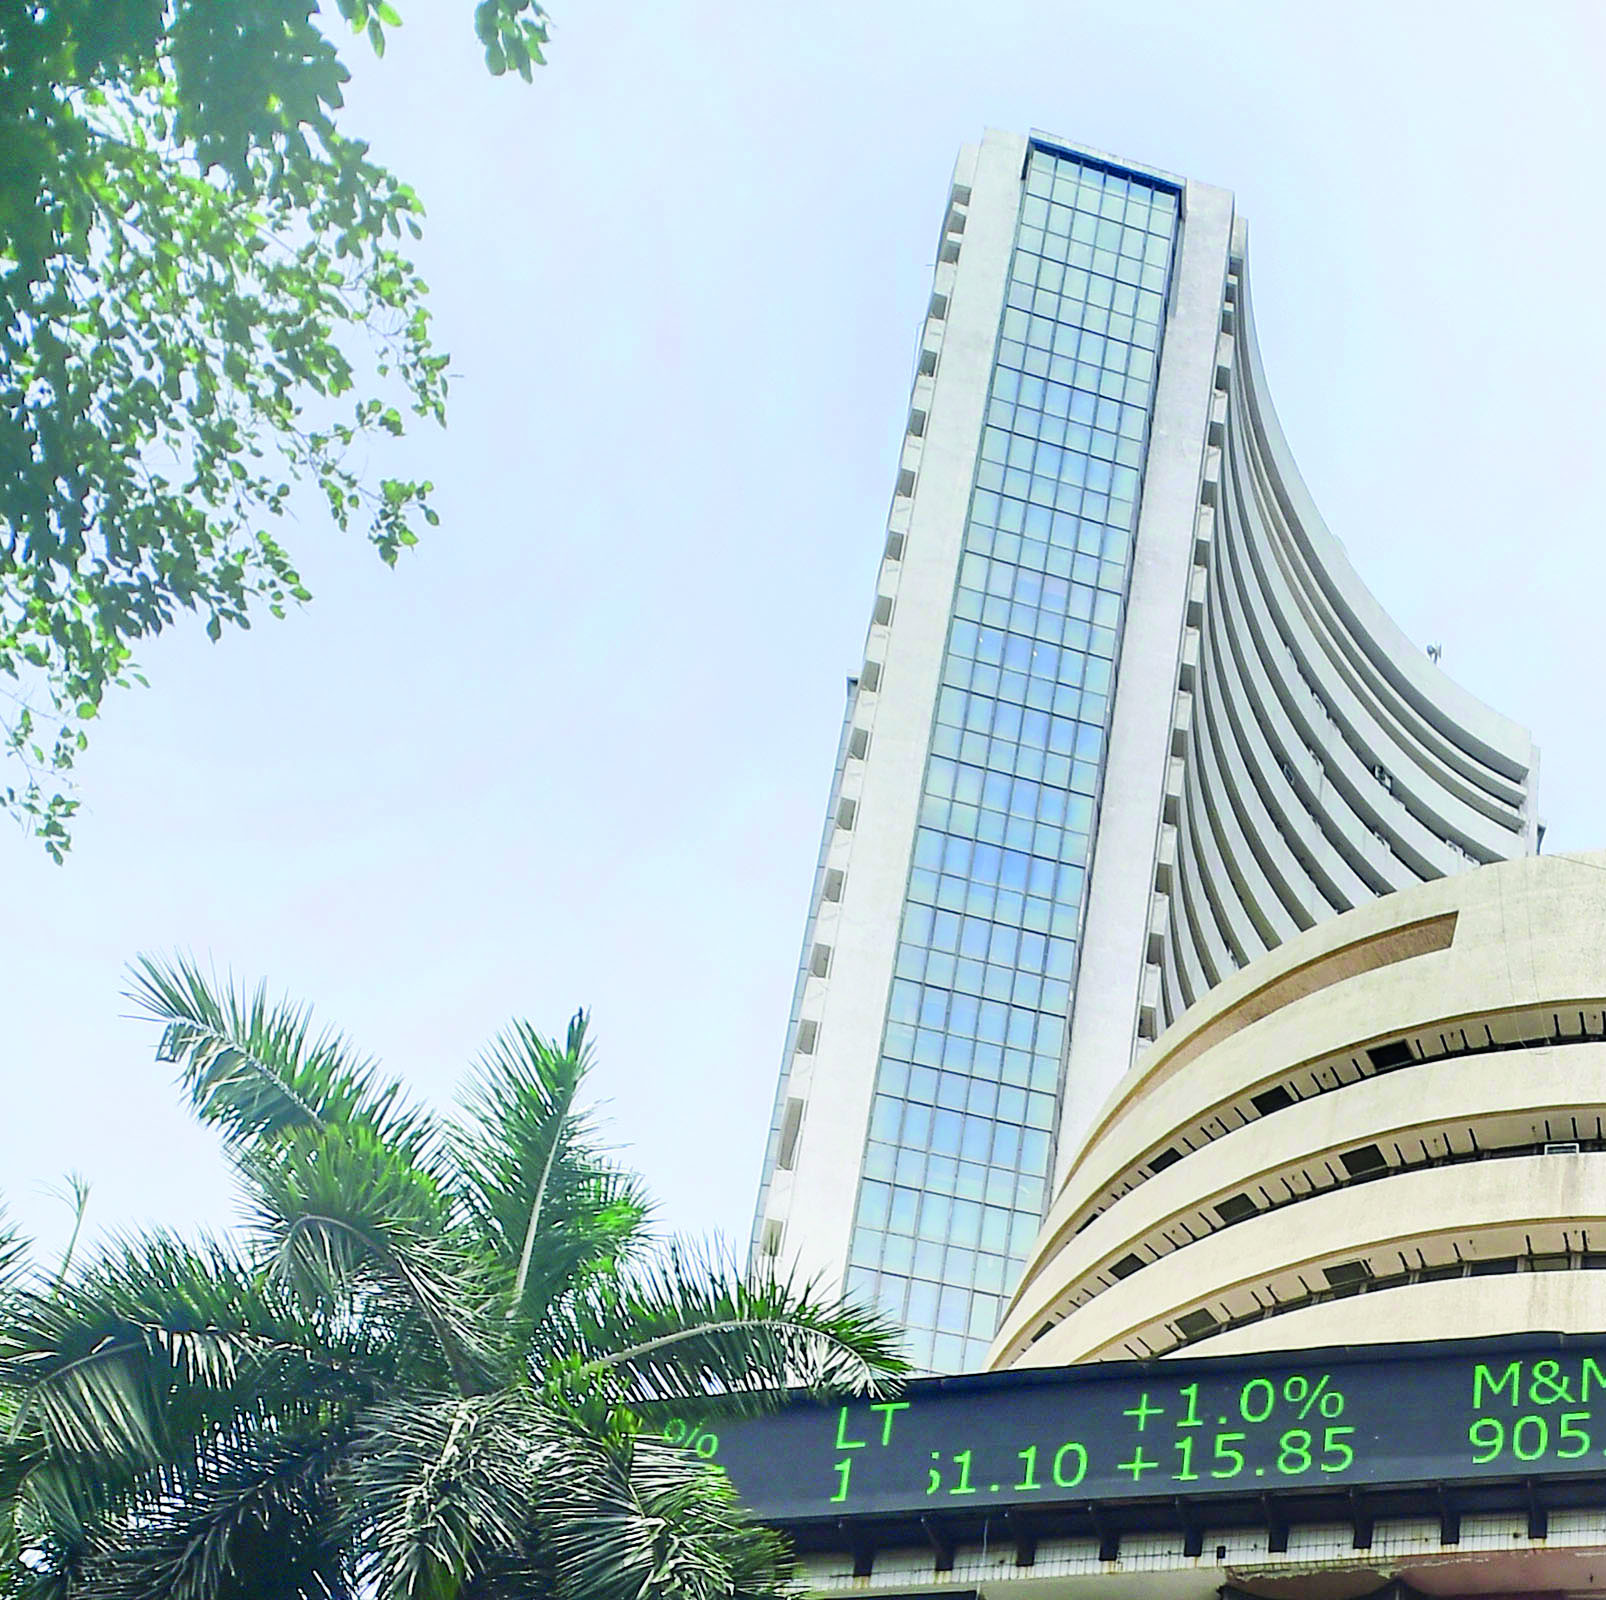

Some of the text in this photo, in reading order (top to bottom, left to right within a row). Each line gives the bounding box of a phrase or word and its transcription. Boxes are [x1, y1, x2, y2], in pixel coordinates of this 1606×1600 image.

[834, 1374, 1346, 1450] LT +1.0%
[1116, 1425, 1356, 1481] +15.85
